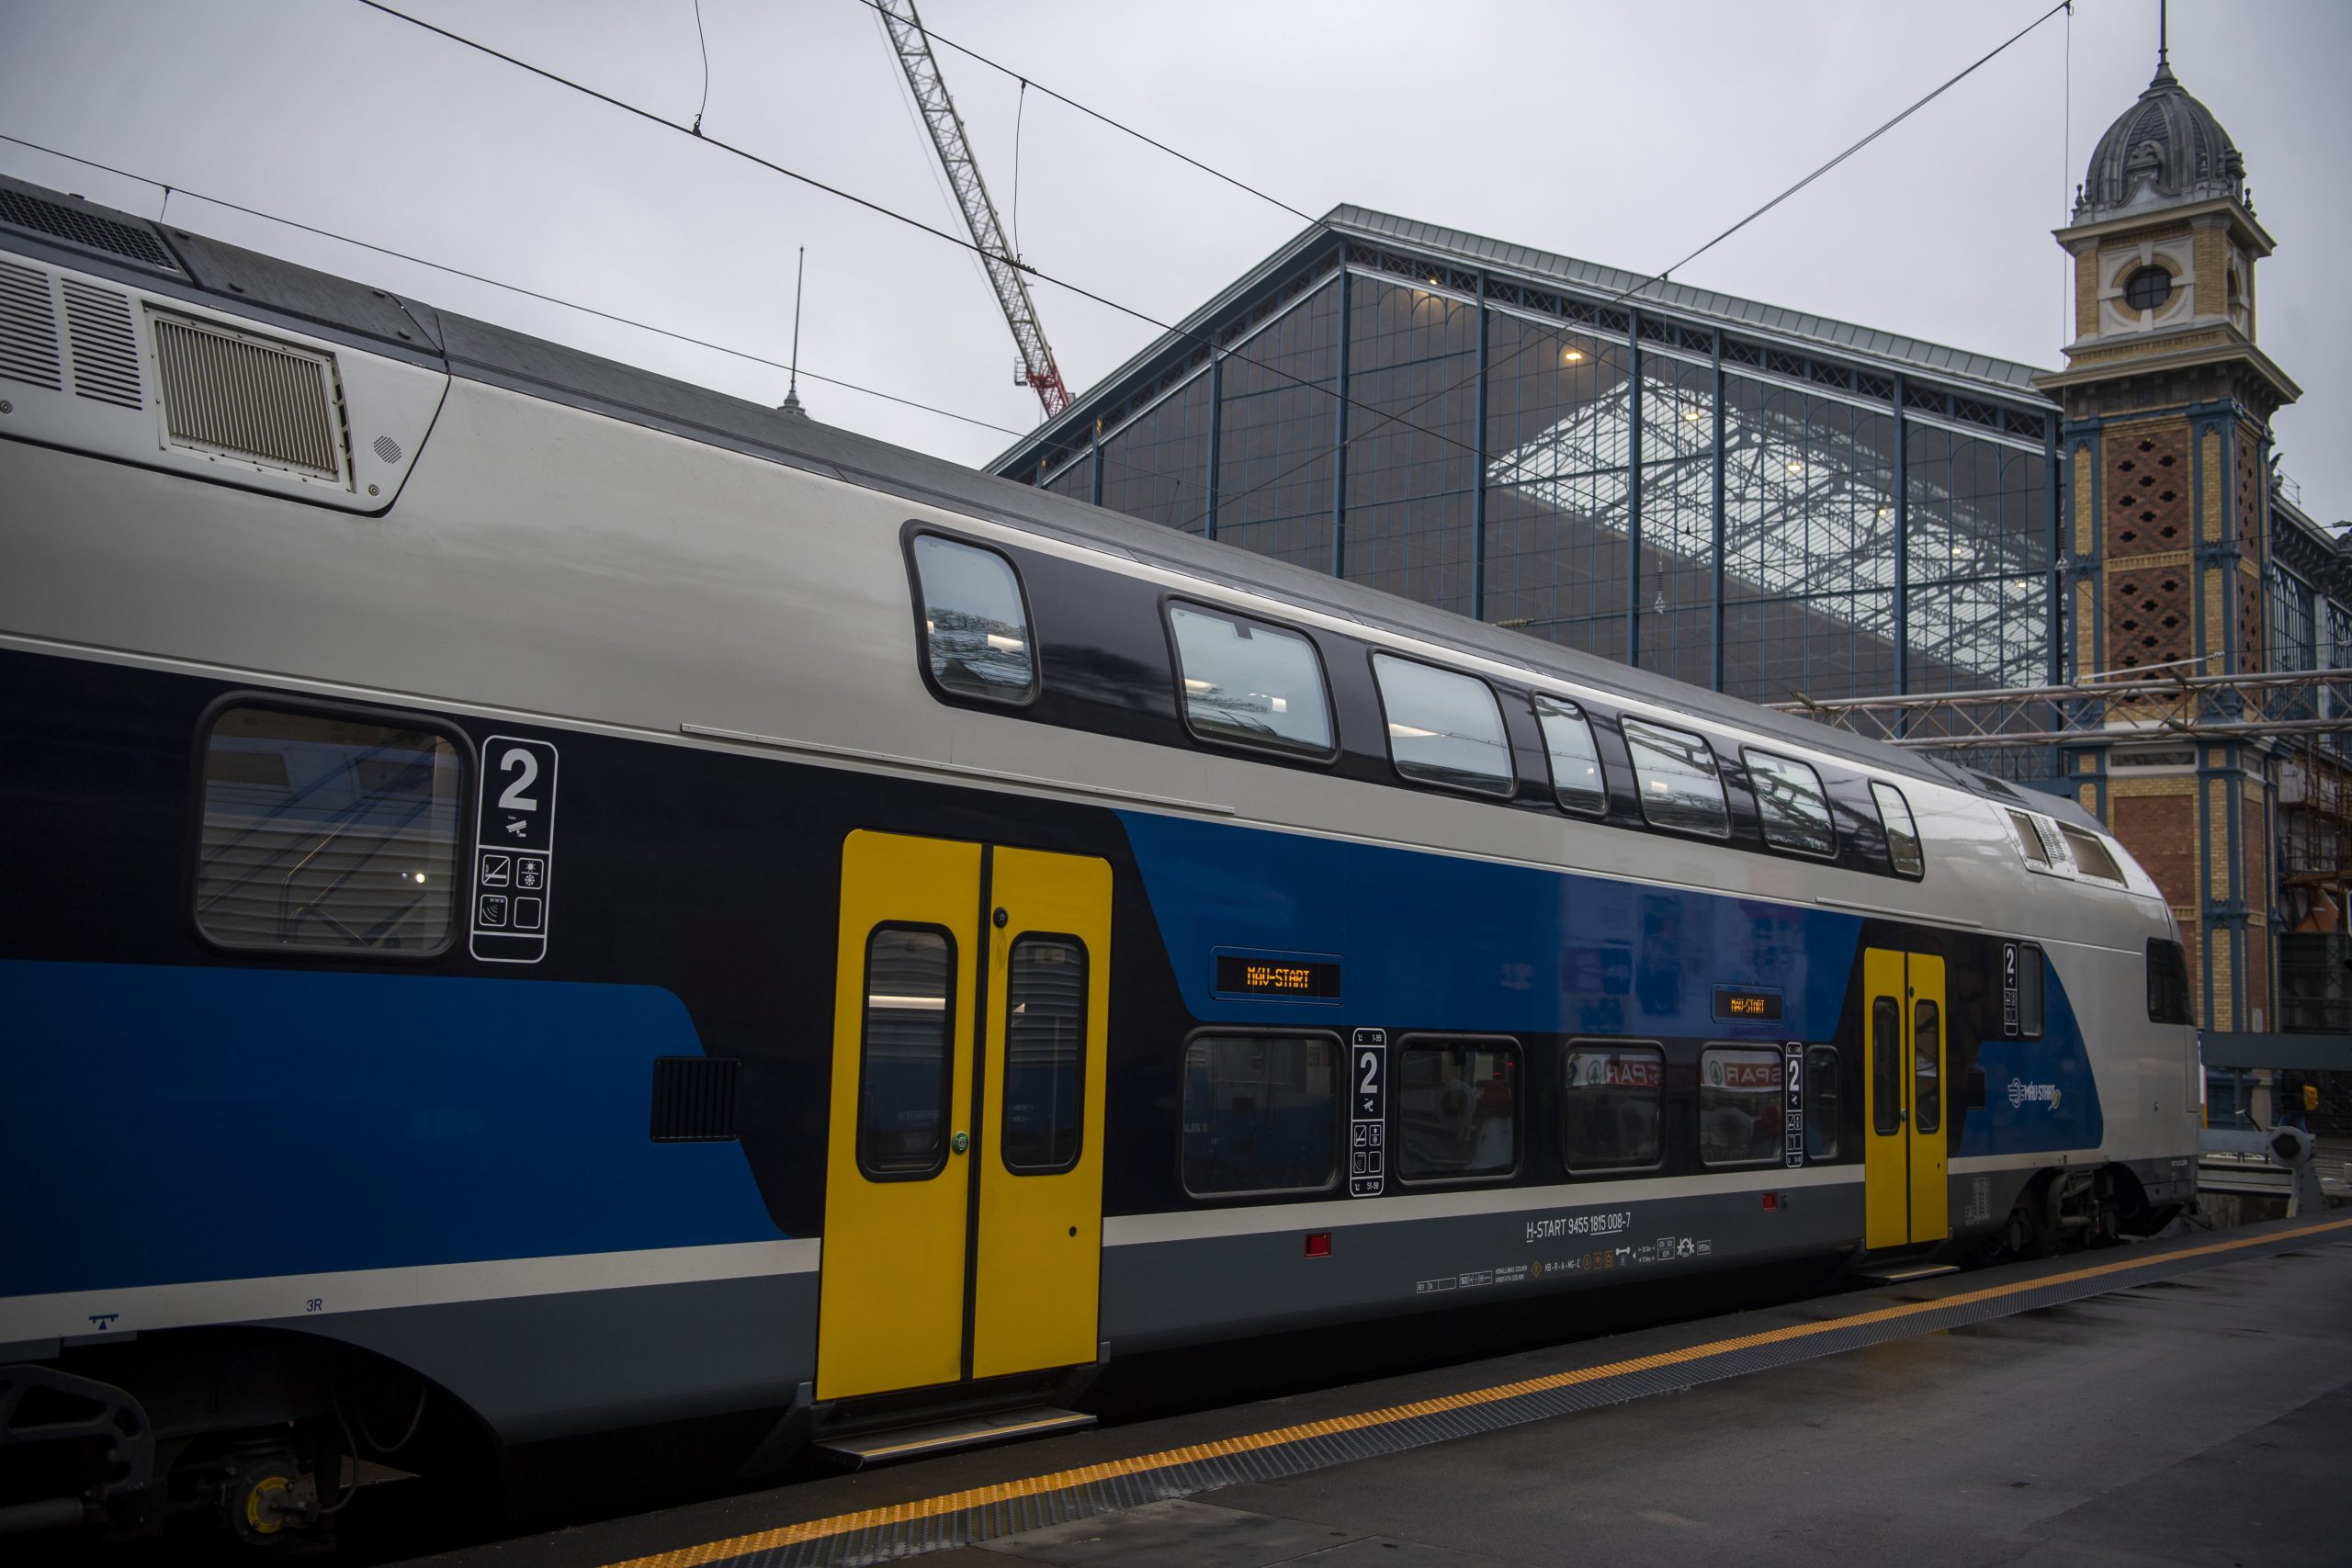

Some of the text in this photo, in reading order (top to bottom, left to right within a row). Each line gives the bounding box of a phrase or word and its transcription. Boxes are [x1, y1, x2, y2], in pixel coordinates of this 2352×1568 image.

[497, 748, 539, 812] 2
[2007, 948, 2015, 975] 2
[1359, 1052, 1378, 1094] 2
[1789, 1059, 1800, 1092] 2
[1526, 1212, 1631, 1240] H-START 9455 1815 008-7
[306, 1298, 322, 1313] 3R
